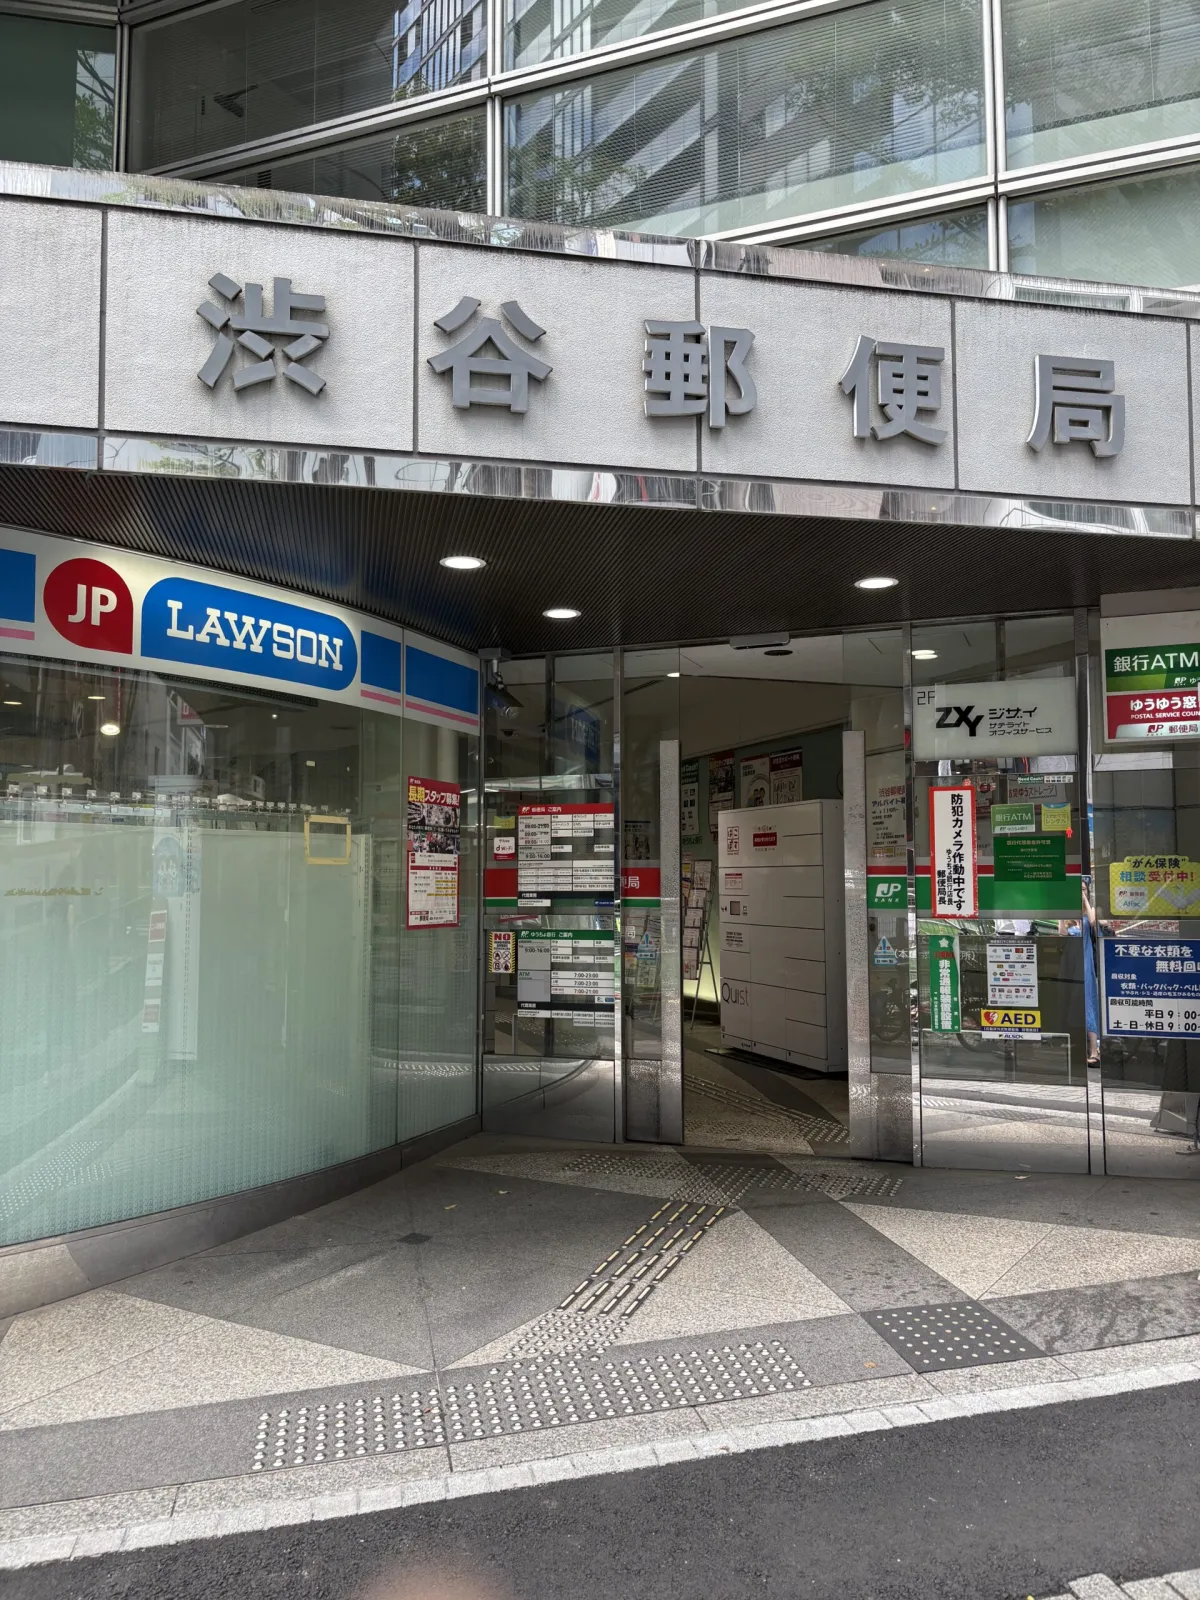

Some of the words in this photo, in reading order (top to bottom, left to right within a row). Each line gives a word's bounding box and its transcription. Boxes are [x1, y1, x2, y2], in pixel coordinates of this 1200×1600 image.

[197, 272, 1127, 459] 渋谷郵便局
[67, 583, 118, 626] JP
[166, 599, 343, 672] LAWSON
[1113, 651, 1200, 673] 銀行ATM
[916, 690, 936, 706] 2F
[1130, 695, 1200, 712] ゆうゆう窓
[988, 706, 1038, 720] ジザイ
[936, 705, 985, 737] ZXY
[988, 721, 1031, 729] サテライト
[988, 727, 1053, 737] オフィスサービス
[1168, 724, 1199, 734] 郵便局
[995, 812, 1032, 822] 銀行ATM
[950, 793, 966, 911] 防犯カメラ作動中です
[1119, 870, 1195, 882] 相談受付中!
[875, 883, 902, 897] JP
[936, 869, 947, 906] 郵便局長
[493, 933, 511, 941] NO
[1114, 944, 1193, 957] 不要な衣類を
[1109, 998, 1154, 1007] 回収可能時間
[1000, 1012, 1036, 1025] AED
